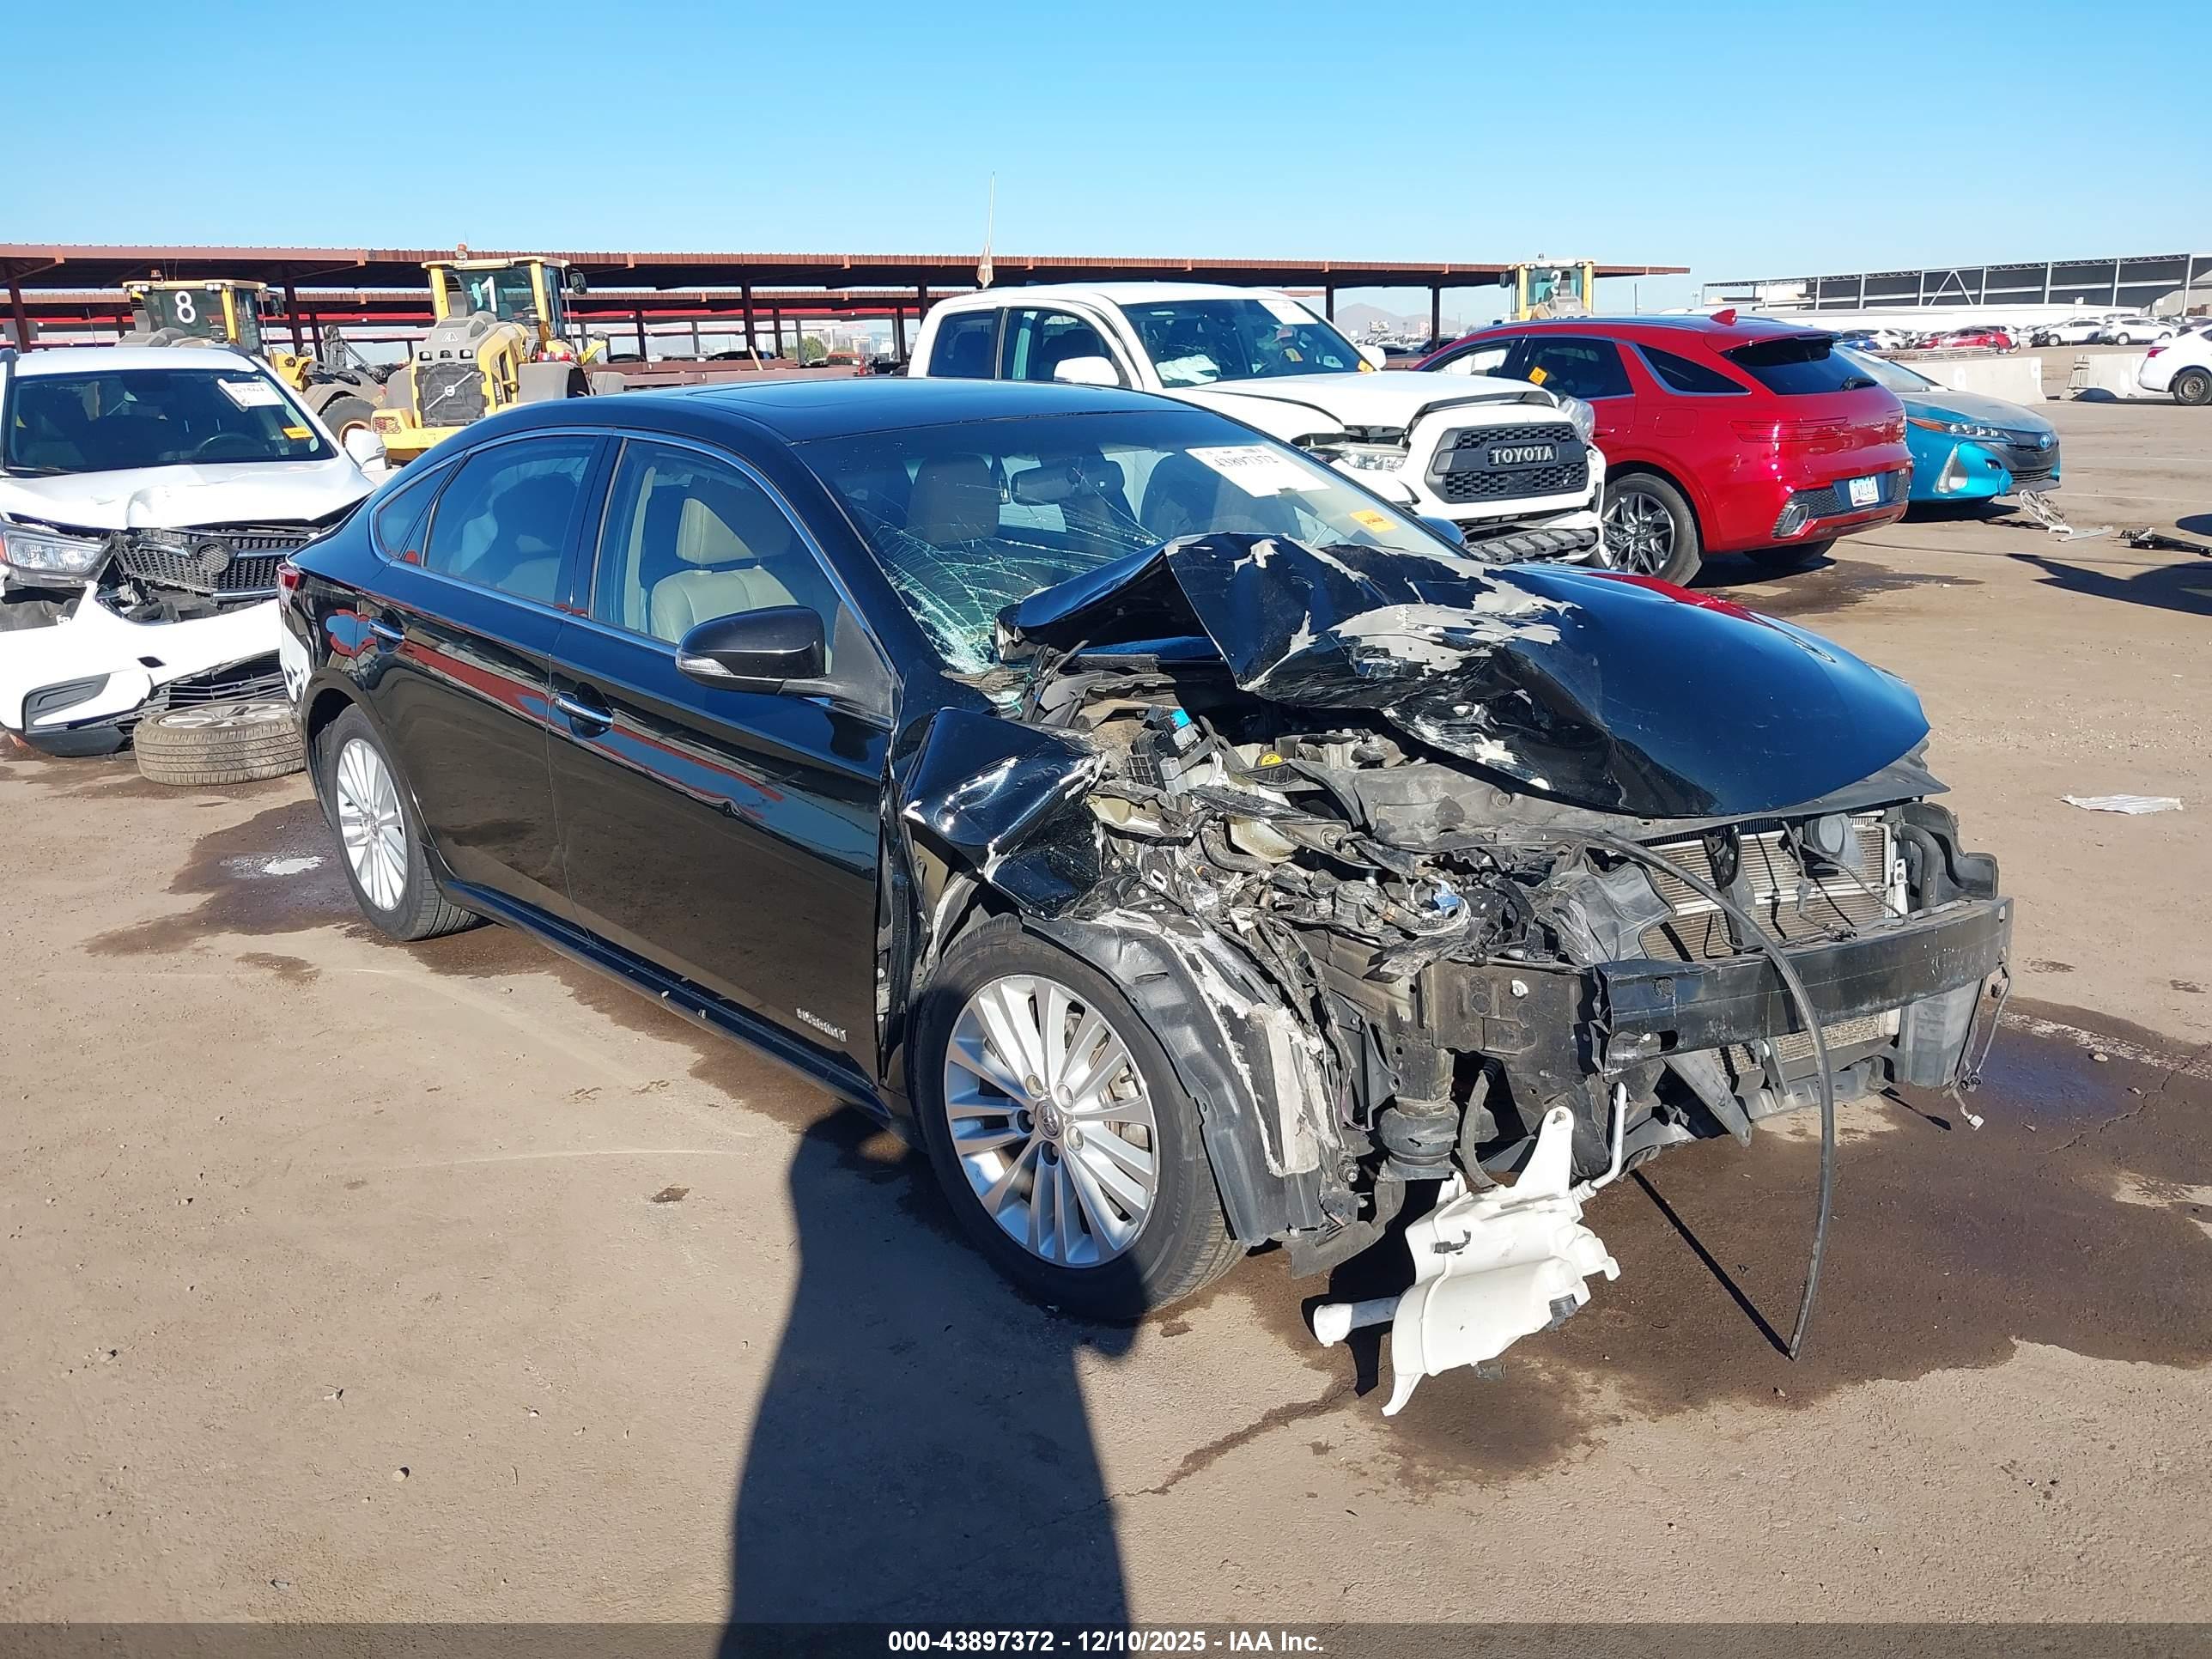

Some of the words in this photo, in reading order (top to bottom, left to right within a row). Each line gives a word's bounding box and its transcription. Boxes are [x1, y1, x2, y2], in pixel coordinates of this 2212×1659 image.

[175, 290, 197, 324] 8
[481, 276, 497, 312] 1
[1492, 446, 1554, 464] TOYOTA
